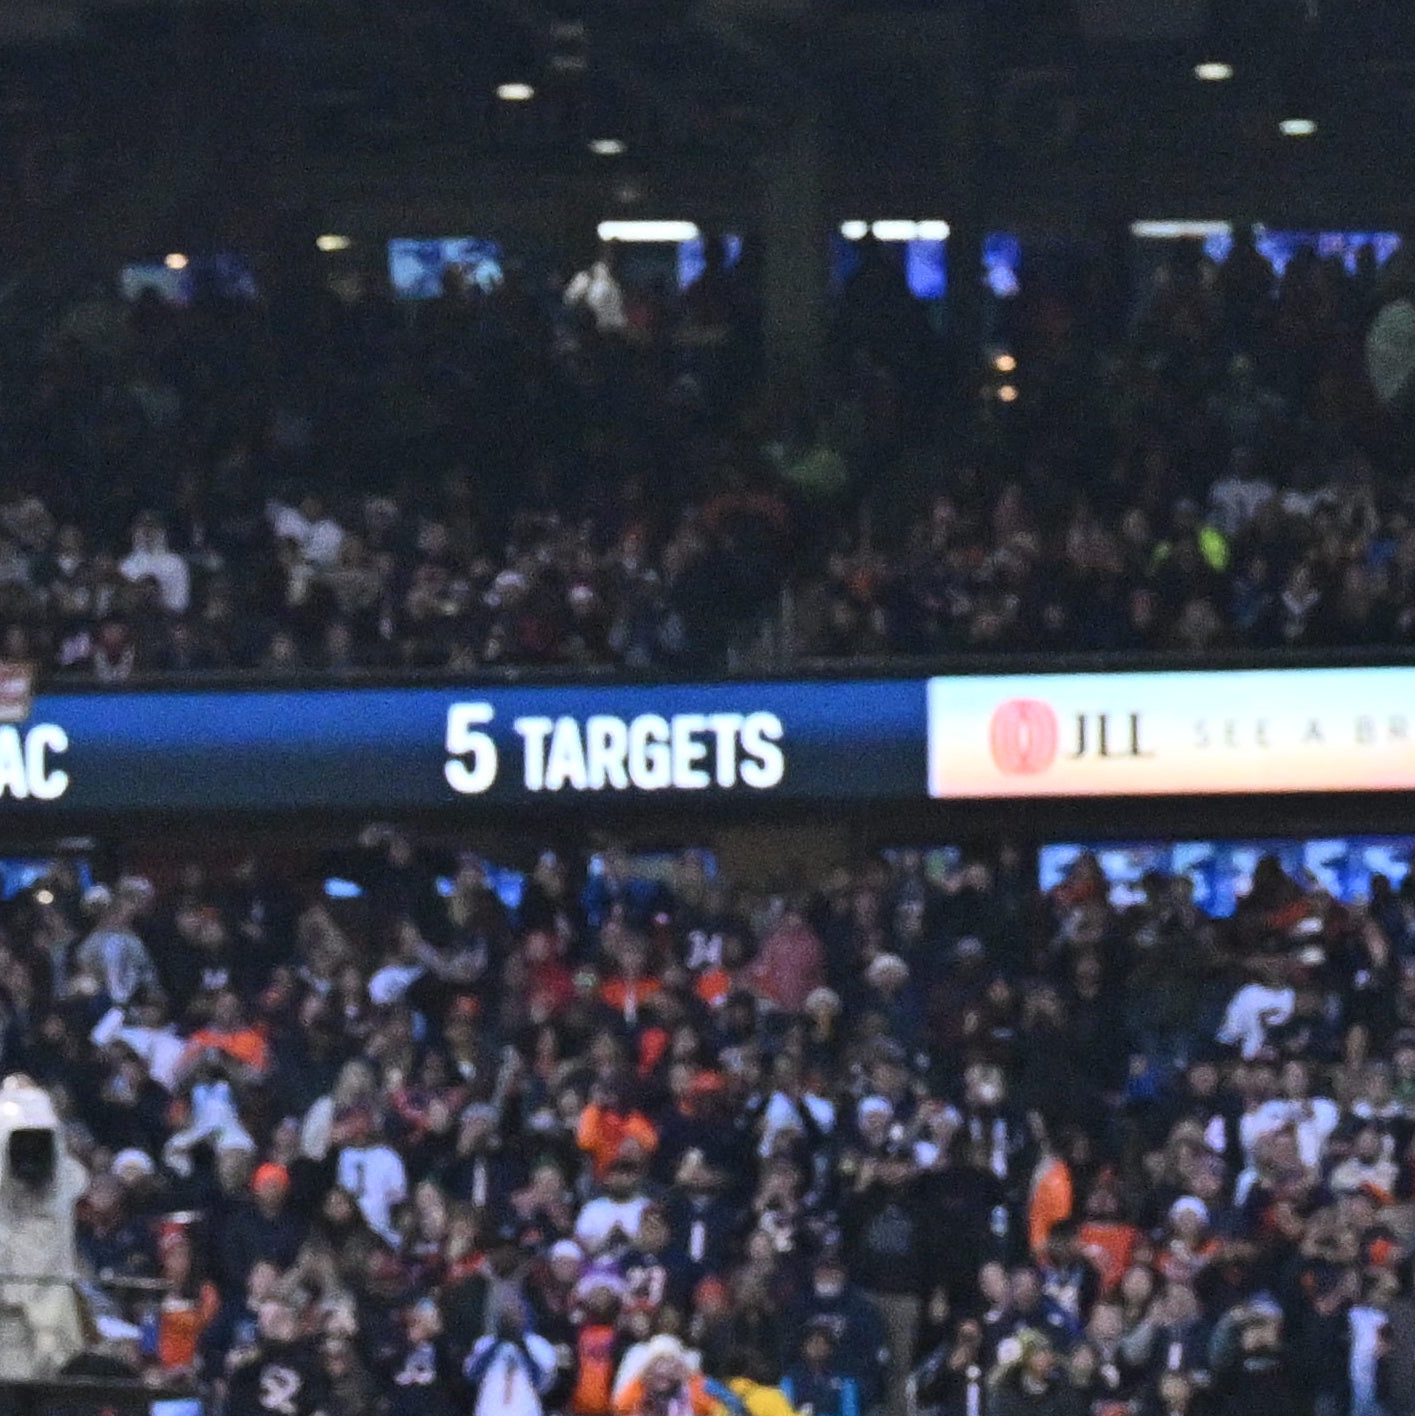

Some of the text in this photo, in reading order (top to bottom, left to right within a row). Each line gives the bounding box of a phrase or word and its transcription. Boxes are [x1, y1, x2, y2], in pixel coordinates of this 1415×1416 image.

[444, 701, 784, 794] 5 TARGETS
[1065, 712, 1156, 760] JLL
[1193, 718, 1272, 749] SEE
[1305, 716, 1325, 744] A
